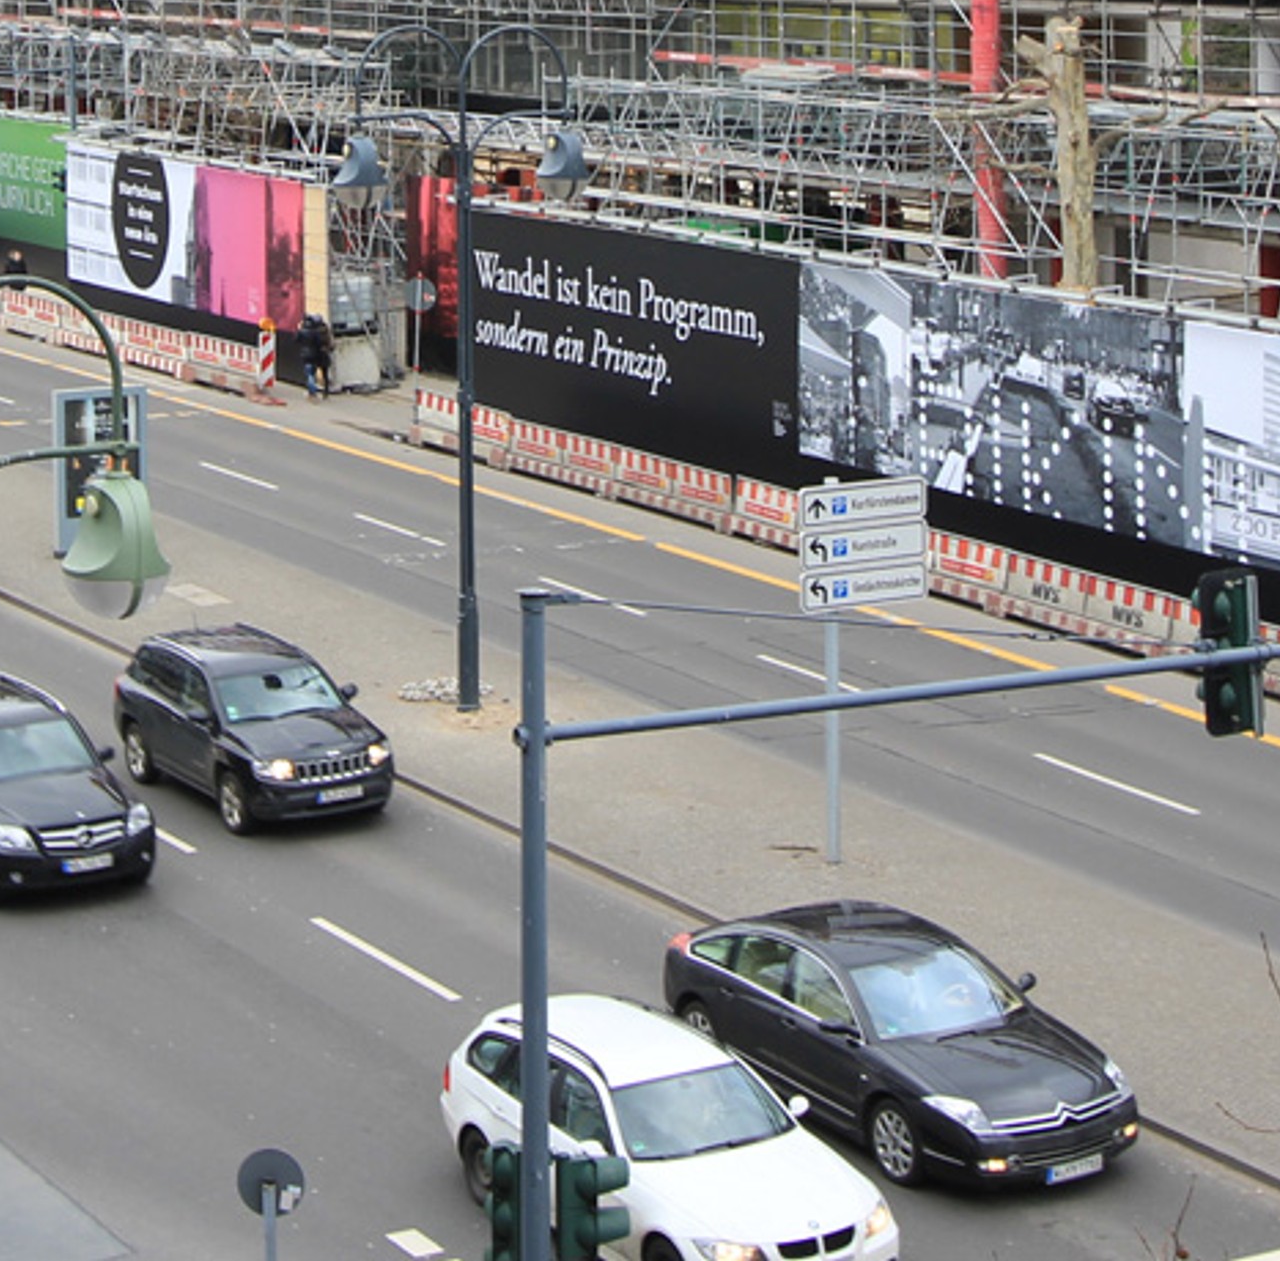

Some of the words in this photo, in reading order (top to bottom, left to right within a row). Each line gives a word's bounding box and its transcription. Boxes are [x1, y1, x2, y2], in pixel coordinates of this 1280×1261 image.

[474, 250, 550, 300] Wandel
[557, 267, 581, 305] ist
[587, 266, 631, 316] kein
[639, 278, 765, 347] Programm,
[475, 310, 548, 357] sondern
[554, 326, 584, 364] ein
[590, 328, 672, 395] Prinzip.
